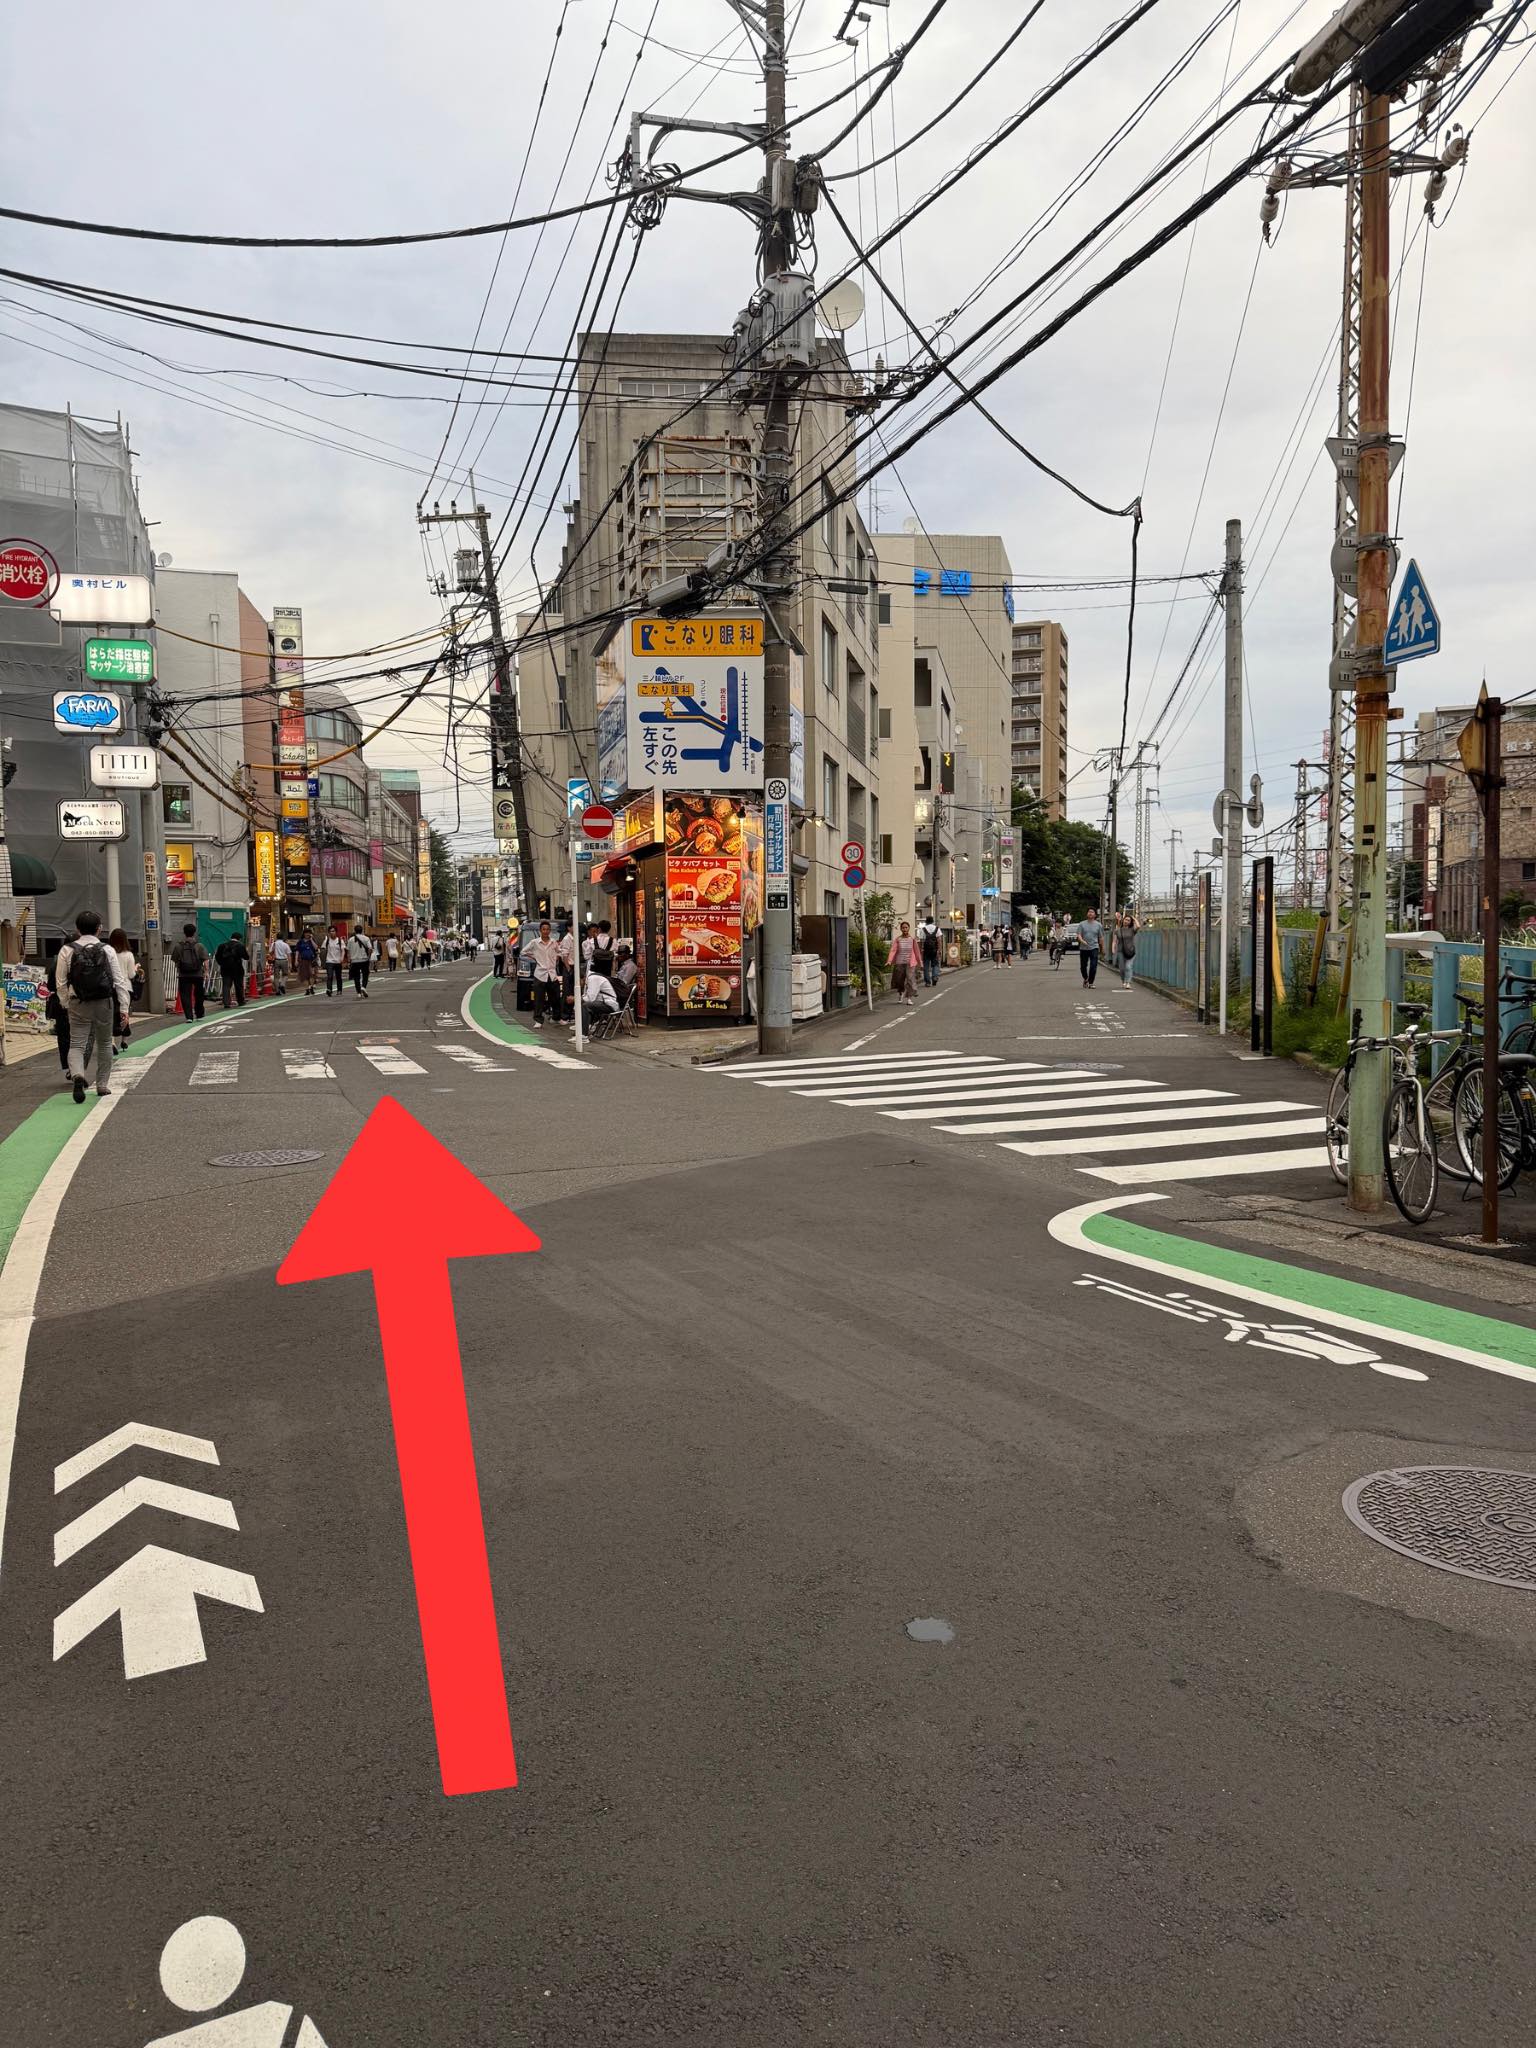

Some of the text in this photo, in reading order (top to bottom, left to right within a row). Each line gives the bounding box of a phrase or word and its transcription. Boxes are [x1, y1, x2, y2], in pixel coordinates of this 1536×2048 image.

[0, 564, 43, 585] 消火栓
[72, 579, 127, 589] 奥村ビル
[665, 624, 755, 645] こなり眼科
[89, 647, 150, 661] はらだ指圧整体
[90, 660, 150, 674] マッサージ治療室
[641, 685, 691, 695] こなり眼科
[68, 699, 111, 714] FARM
[642, 726, 659, 775] 左すぐ
[661, 727, 678, 775] この先
[97, 754, 148, 769] TITTI
[846, 848, 859, 859] 30
[7, 982, 34, 992] FARM
